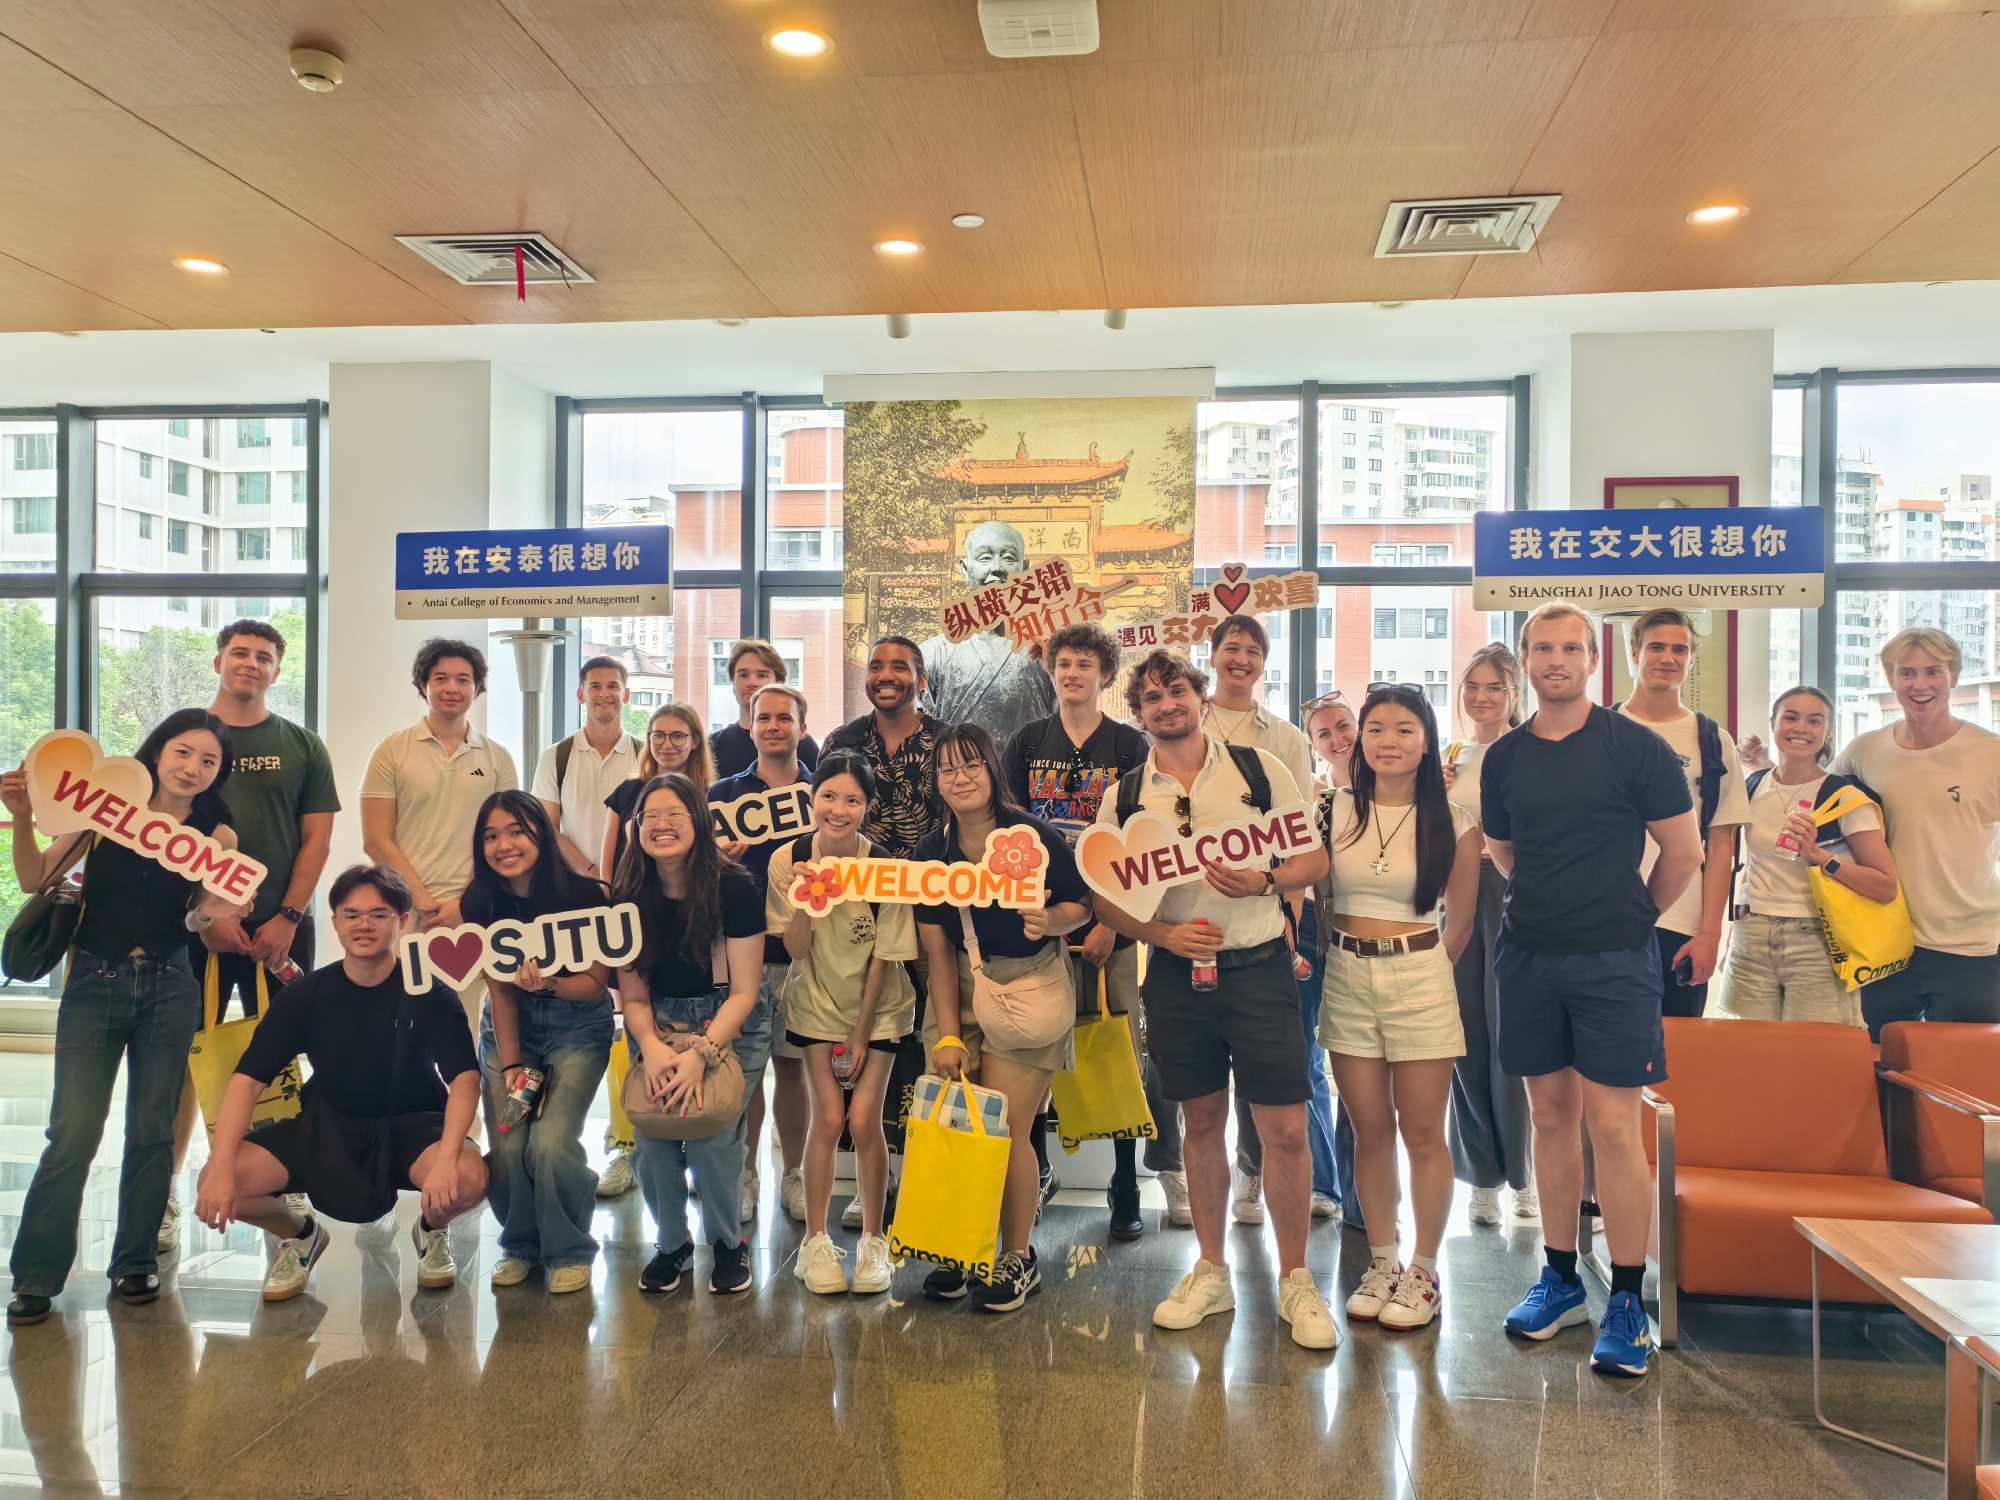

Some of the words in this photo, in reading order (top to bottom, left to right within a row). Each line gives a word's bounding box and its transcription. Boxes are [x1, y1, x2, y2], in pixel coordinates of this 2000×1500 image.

[423, 541, 641, 576] 我在安泰很想你
[1509, 524, 1788, 560] 我在交大很想你
[422, 597, 448, 607] Antai
[451, 597, 487, 609] College
[489, 595, 500, 606] of
[501, 595, 552, 606] Economics
[555, 594, 573, 605] and
[576, 593, 641, 607] Management
[943, 561, 1072, 639] 纵横交错
[1508, 585, 1593, 598] SHANGHAI
[1599, 585, 1633, 600] JIAO
[1636, 584, 1683, 597] TONG
[1687, 584, 1787, 597] UNIVERSITY
[53, 770, 257, 897] WELCOME
[1110, 810, 1313, 891] WELCOME
[833, 862, 1038, 903] WELCOME
[408, 941, 423, 987] I
[490, 911, 634, 975] SJTU
[1062, 1122, 1153, 1148] Cpus
